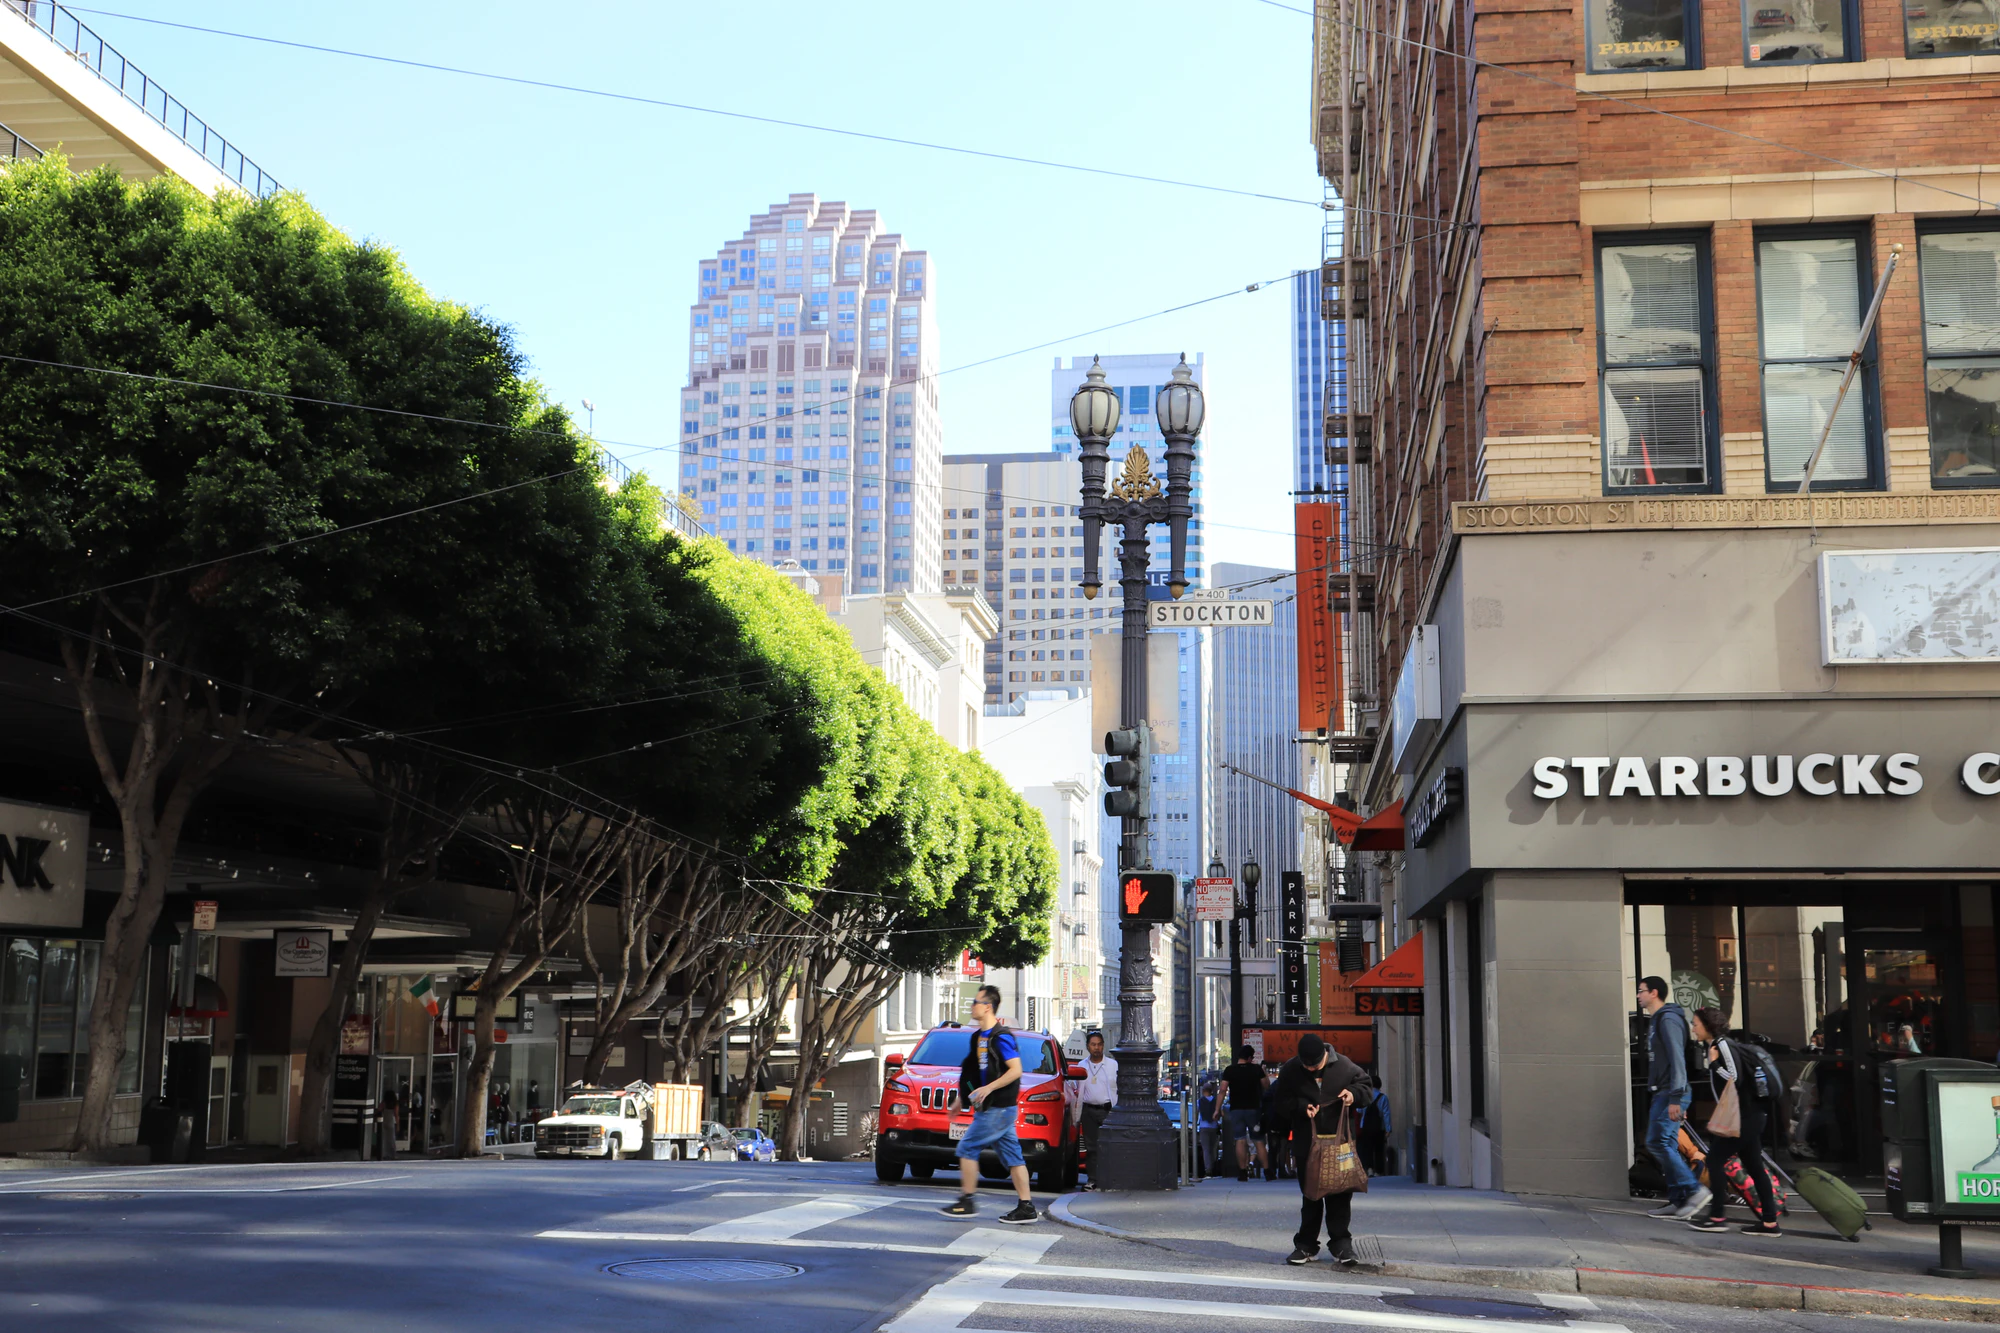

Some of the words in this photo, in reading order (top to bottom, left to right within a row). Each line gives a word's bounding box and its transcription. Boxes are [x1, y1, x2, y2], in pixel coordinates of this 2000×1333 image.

[1913, 24, 1999, 39] PRIMP
[1598, 40, 1680, 55] PRIMP
[1465, 504, 1589, 528] STOCKTON
[1312, 519, 1325, 627] BASHFORD
[1206, 590, 1225, 599] 400
[1157, 605, 1265, 622] STOCKTON
[1314, 639, 1326, 714] WILKES
[1533, 752, 1924, 799] STARBUCKS
[1288, 882, 1297, 934] PARK
[1358, 995, 1423, 1013] SALE
